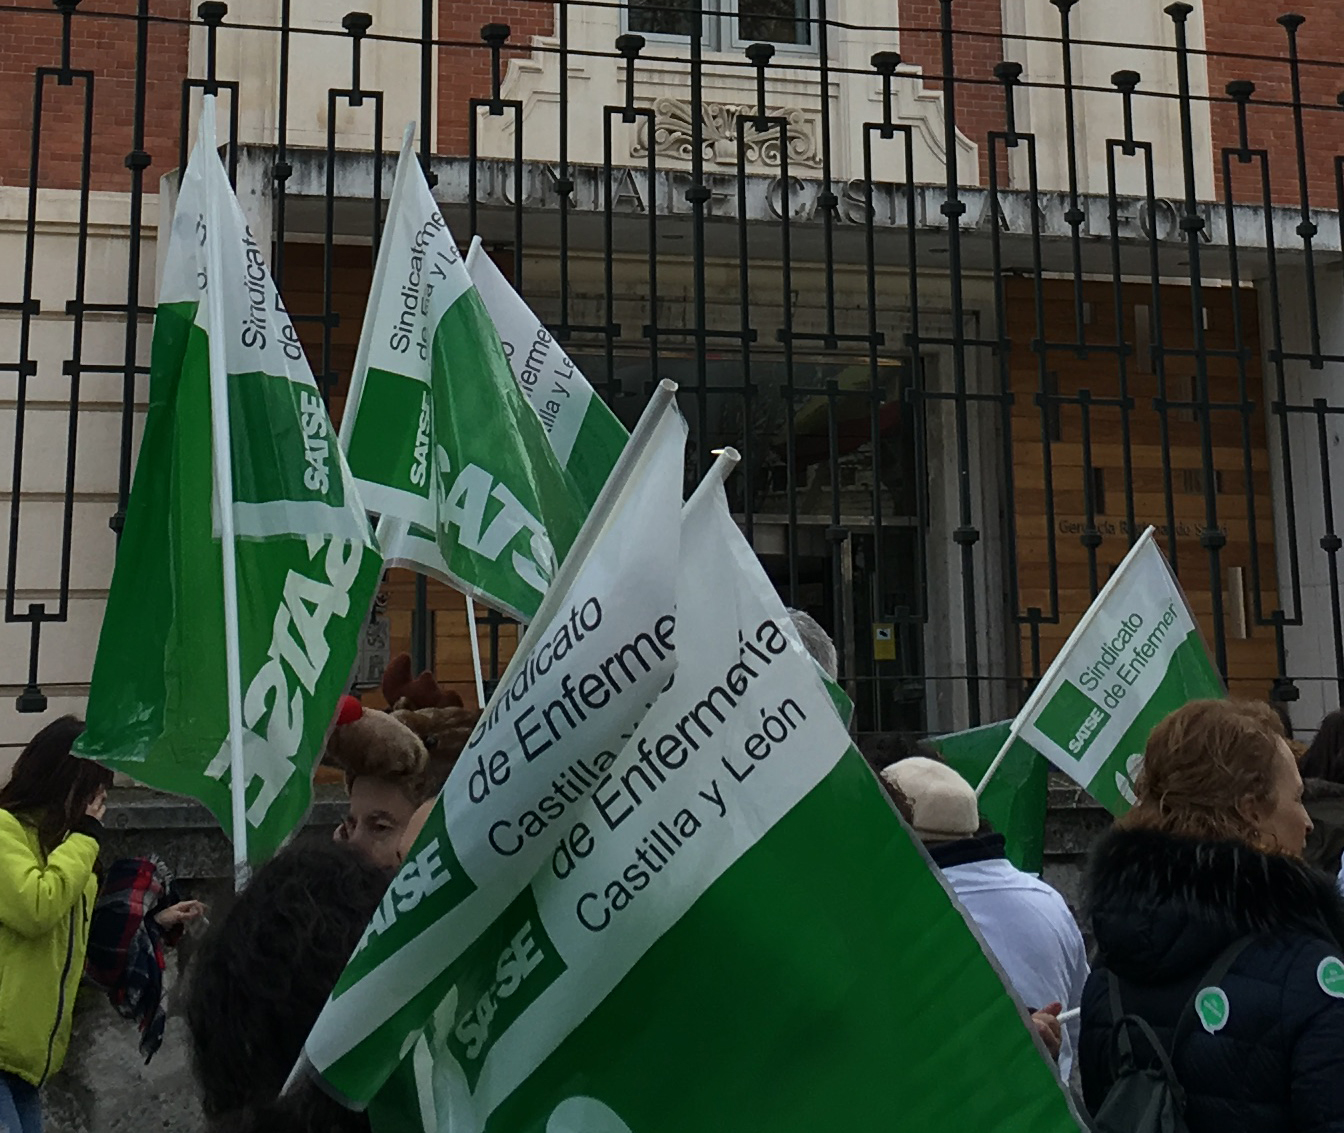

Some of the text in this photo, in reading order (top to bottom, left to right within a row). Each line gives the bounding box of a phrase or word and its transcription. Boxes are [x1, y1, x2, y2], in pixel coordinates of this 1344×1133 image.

[276, 325, 302, 360] de
[300, 391, 330, 494] SATSE
[1079, 612, 1144, 692] Sindicato
[1068, 707, 1105, 754] SATSE
[1103, 683, 1126, 710] de
[467, 749, 513, 805] de
[488, 749, 619, 857] Castilla
[575, 807, 704, 933] Castilla
[698, 778, 728, 818] y
[721, 697, 808, 784] León
[552, 821, 595, 881] de
[457, 920, 545, 1060] SASE
